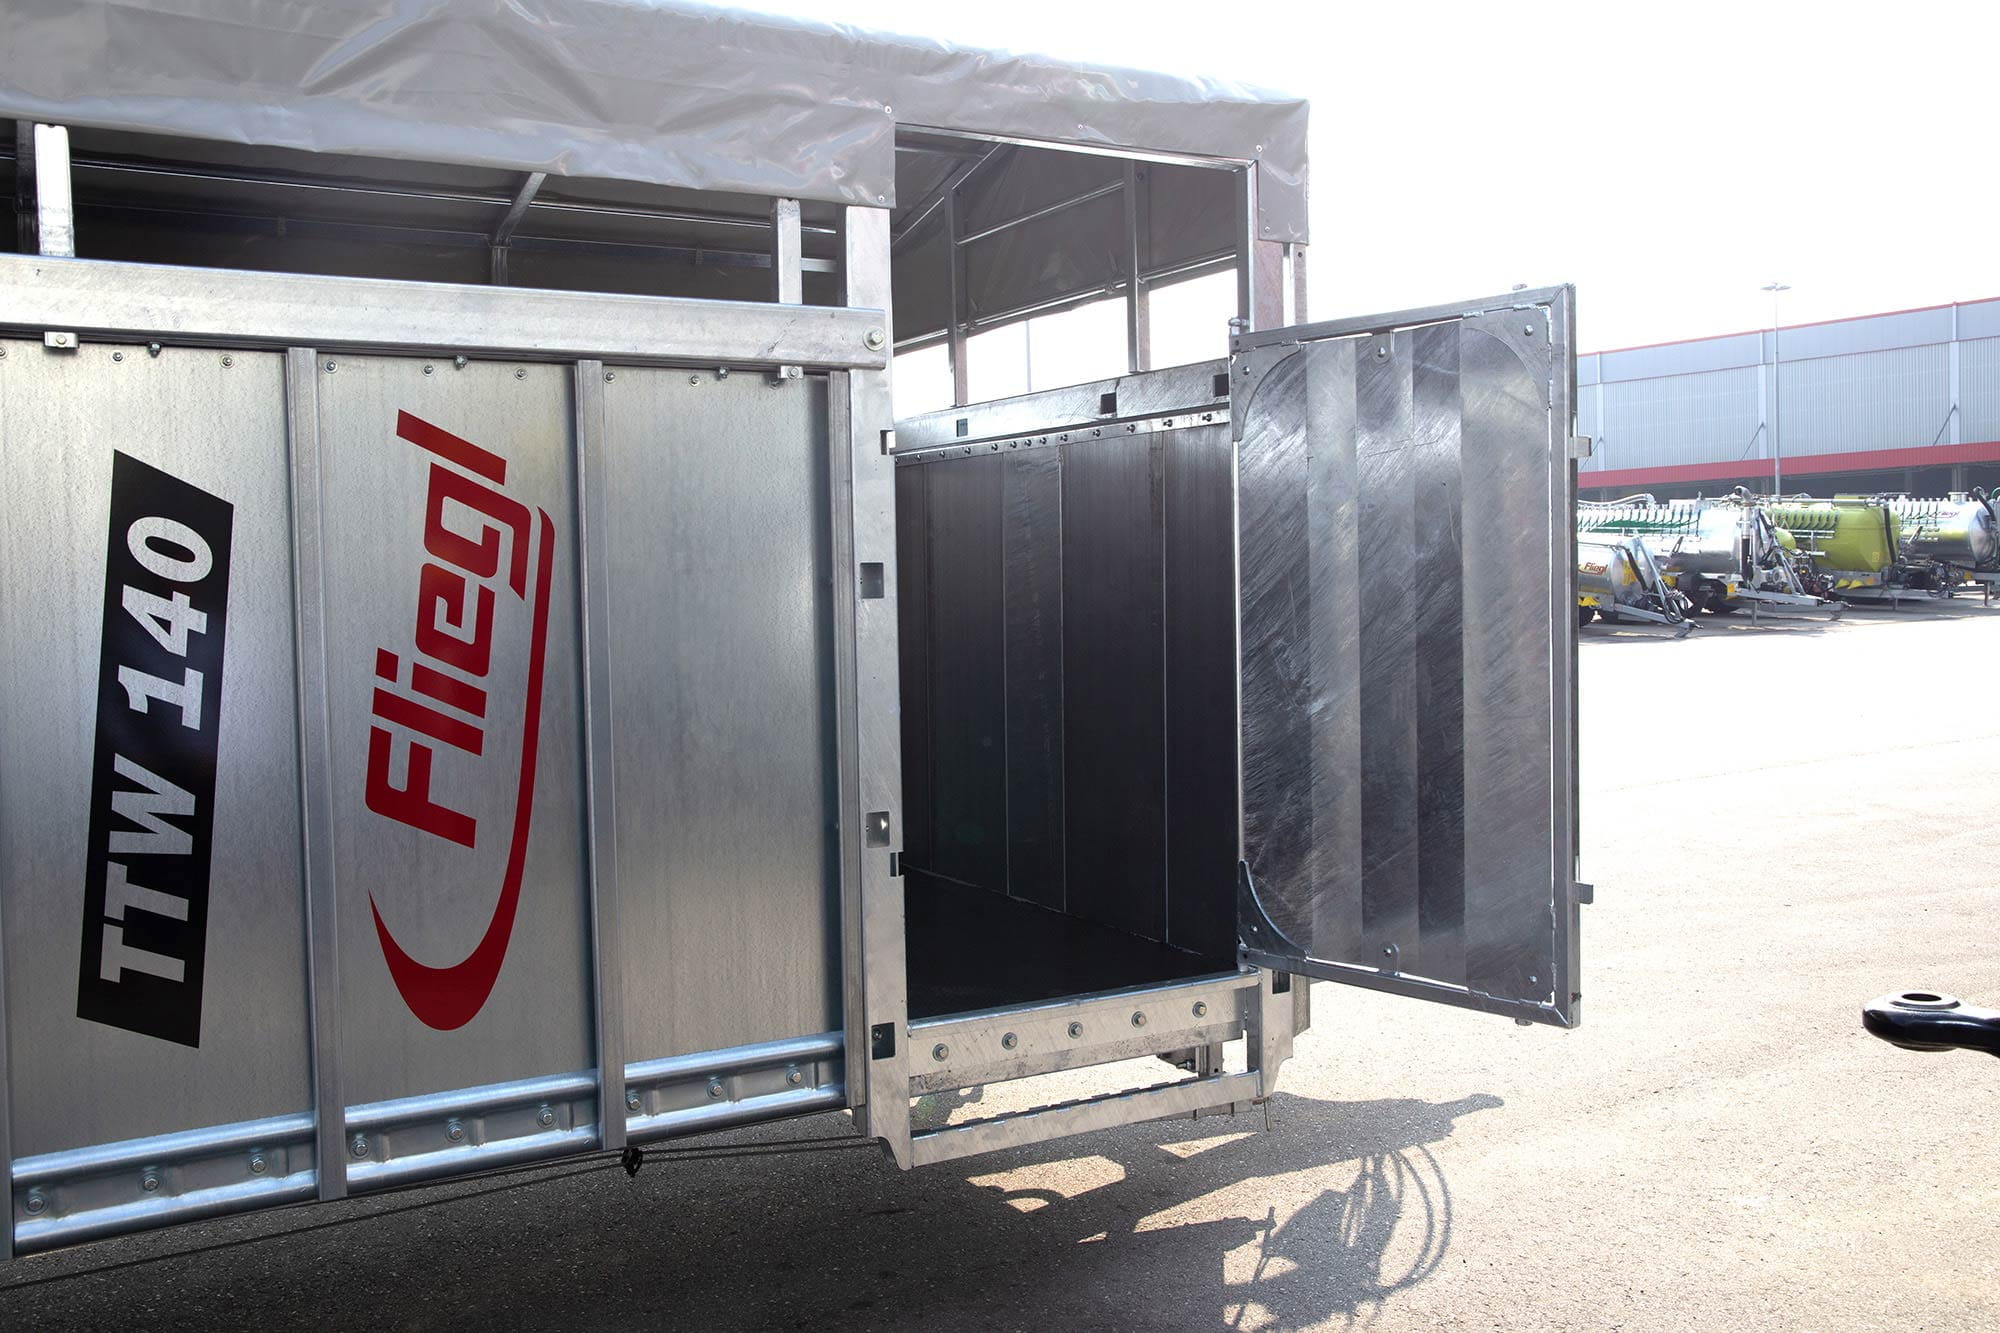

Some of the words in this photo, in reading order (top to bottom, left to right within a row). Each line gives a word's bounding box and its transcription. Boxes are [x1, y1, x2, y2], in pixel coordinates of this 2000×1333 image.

[118, 517, 213, 732] 140
[365, 409, 531, 849] Fliegl
[101, 753, 196, 983] TTW
